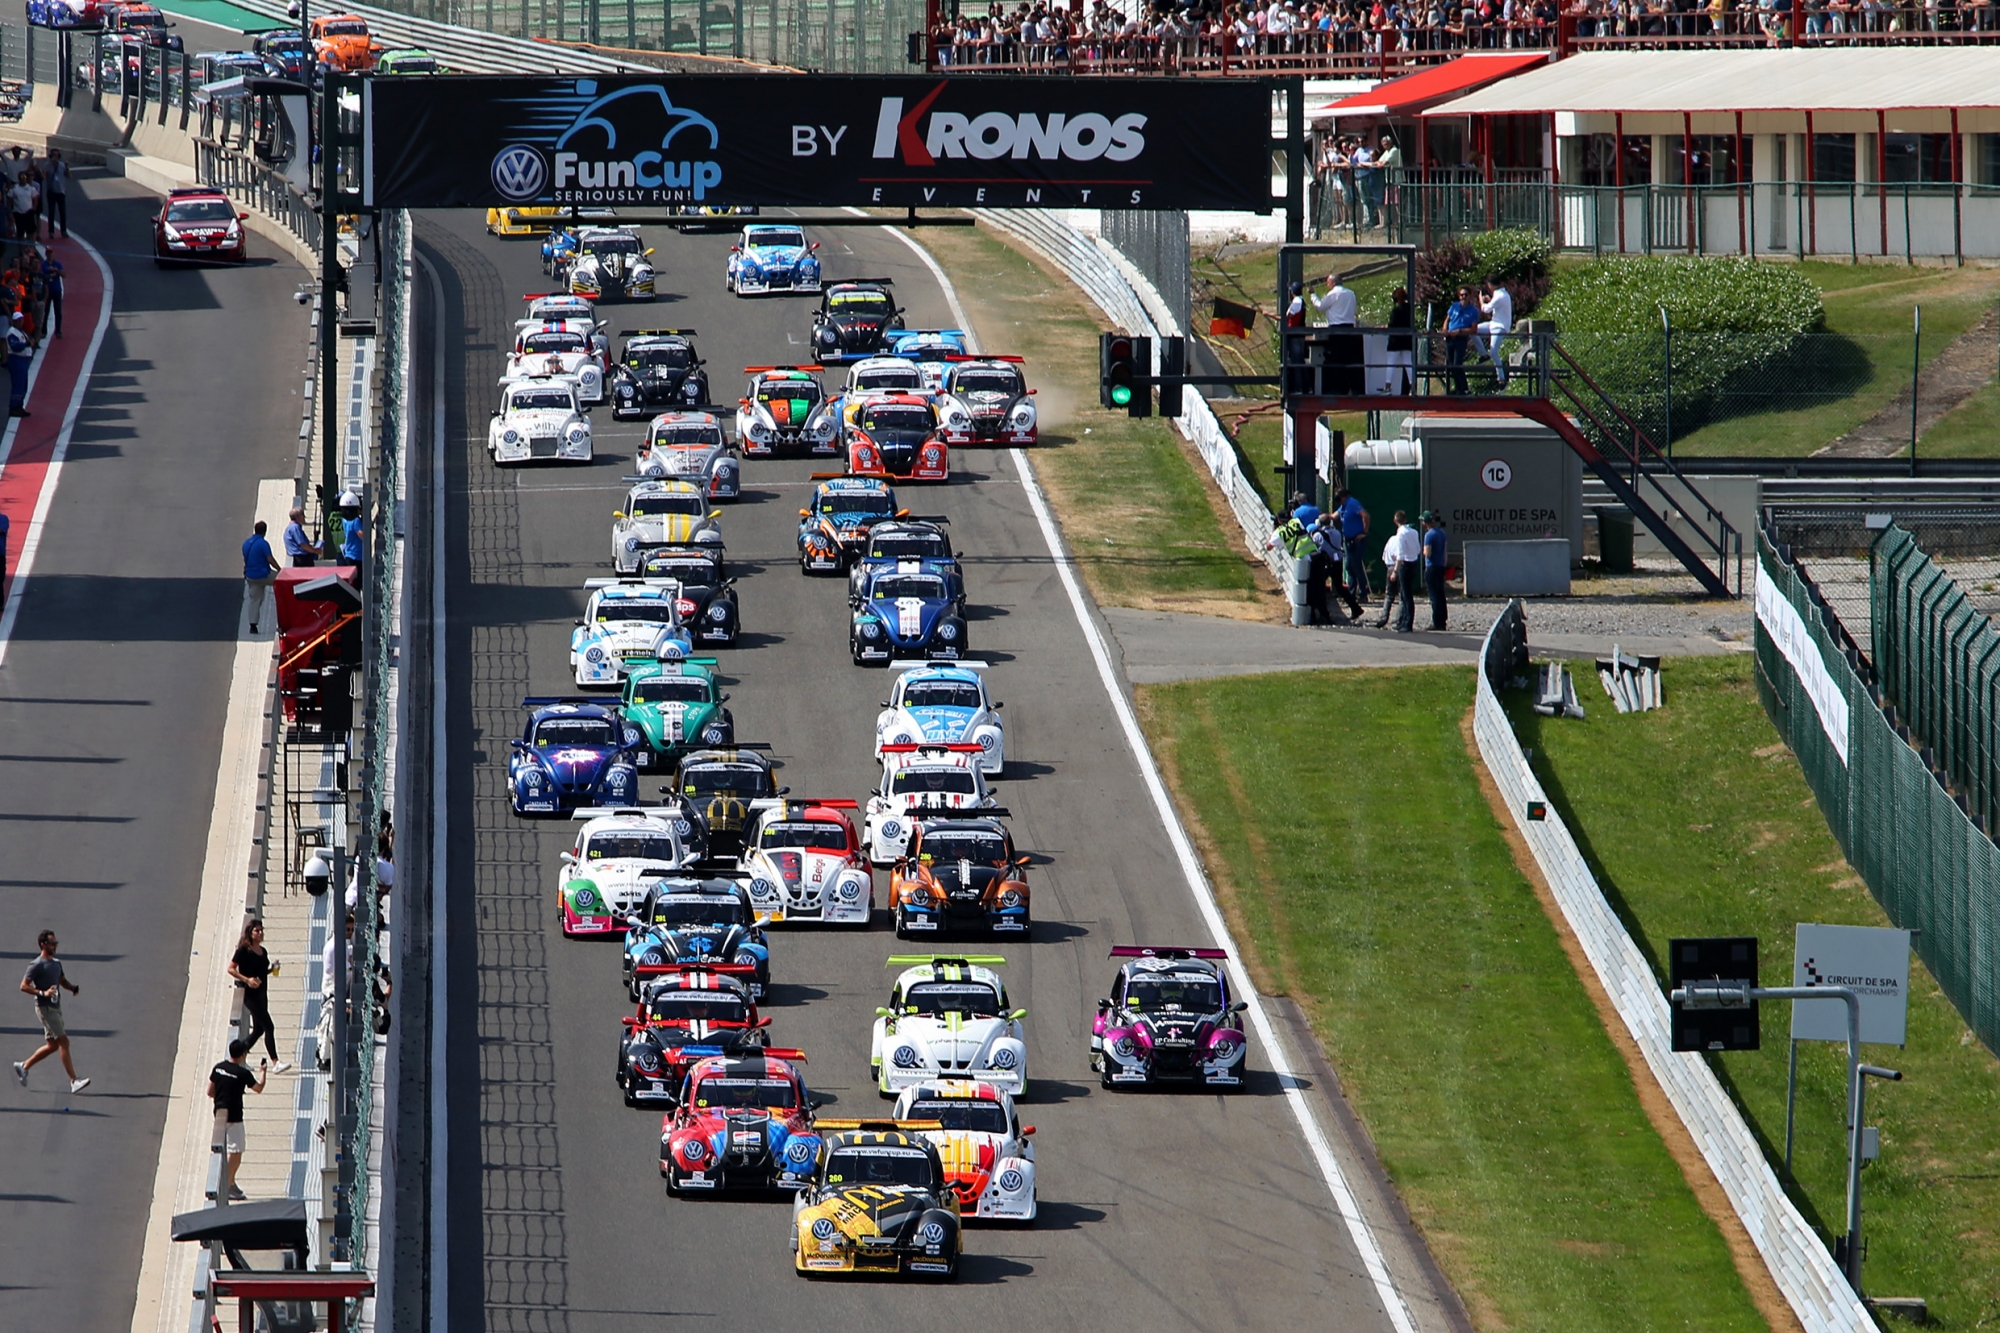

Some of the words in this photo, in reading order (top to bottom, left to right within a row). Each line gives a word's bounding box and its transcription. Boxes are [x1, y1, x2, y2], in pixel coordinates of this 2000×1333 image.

[872, 79, 1148, 166] KRONOS
[792, 125, 848, 156] BY
[555, 151, 722, 200] FunCup
[555, 190, 644, 201] SERIOUSLY
[653, 190, 691, 201] FUN!
[872, 187, 1141, 204] EVENTS
[1487, 467, 1506, 482] 1C
[1453, 508, 1506, 521] CIRCUIT
[1509, 508, 1527, 521] DE
[1530, 509, 1557, 521] SPA
[1453, 523, 1558, 535] FRANCORCHAMPS
[589, 850, 602, 858] 421
[1827, 975, 1863, 985] CIRCUIT
[1865, 976, 1878, 986] DE
[1879, 978, 1898, 987] SPA
[1848, 986, 1900, 997] ORCHAMPS
[829, 1174, 843, 1183] 260
